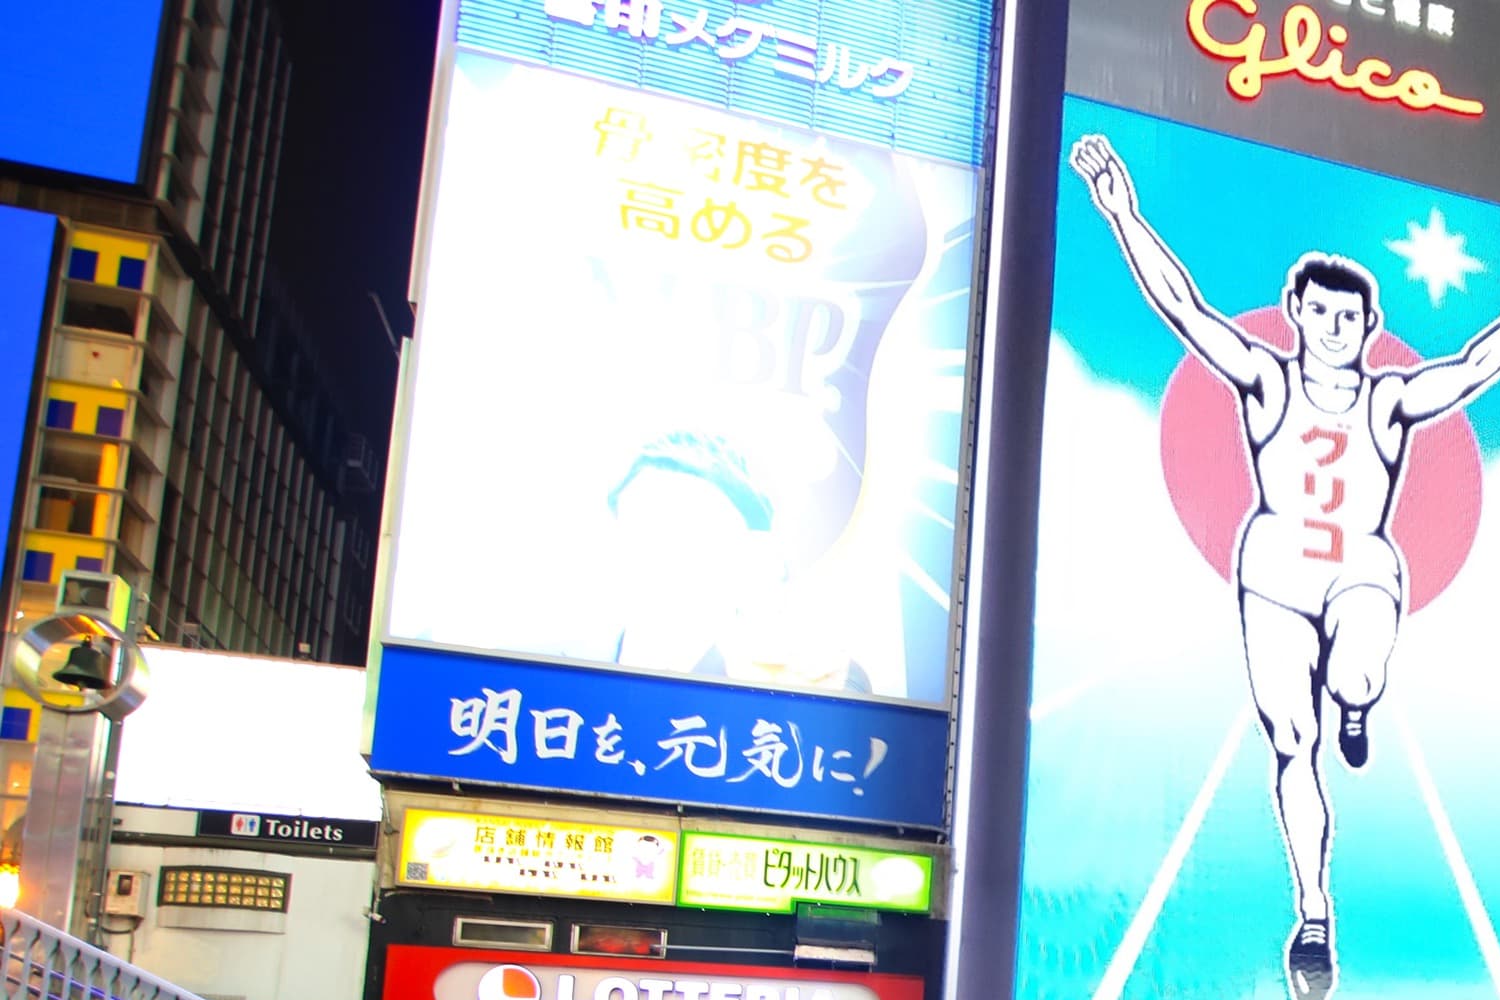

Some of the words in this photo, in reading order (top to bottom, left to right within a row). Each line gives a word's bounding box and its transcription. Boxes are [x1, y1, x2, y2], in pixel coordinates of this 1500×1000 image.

[1188, 0, 1484, 117] Glico
[618, 177, 814, 264] 高める
[1300, 422, 1350, 564] グリコ
[265, 818, 343, 842] Toilets
[763, 849, 863, 897] ピタットハウス
